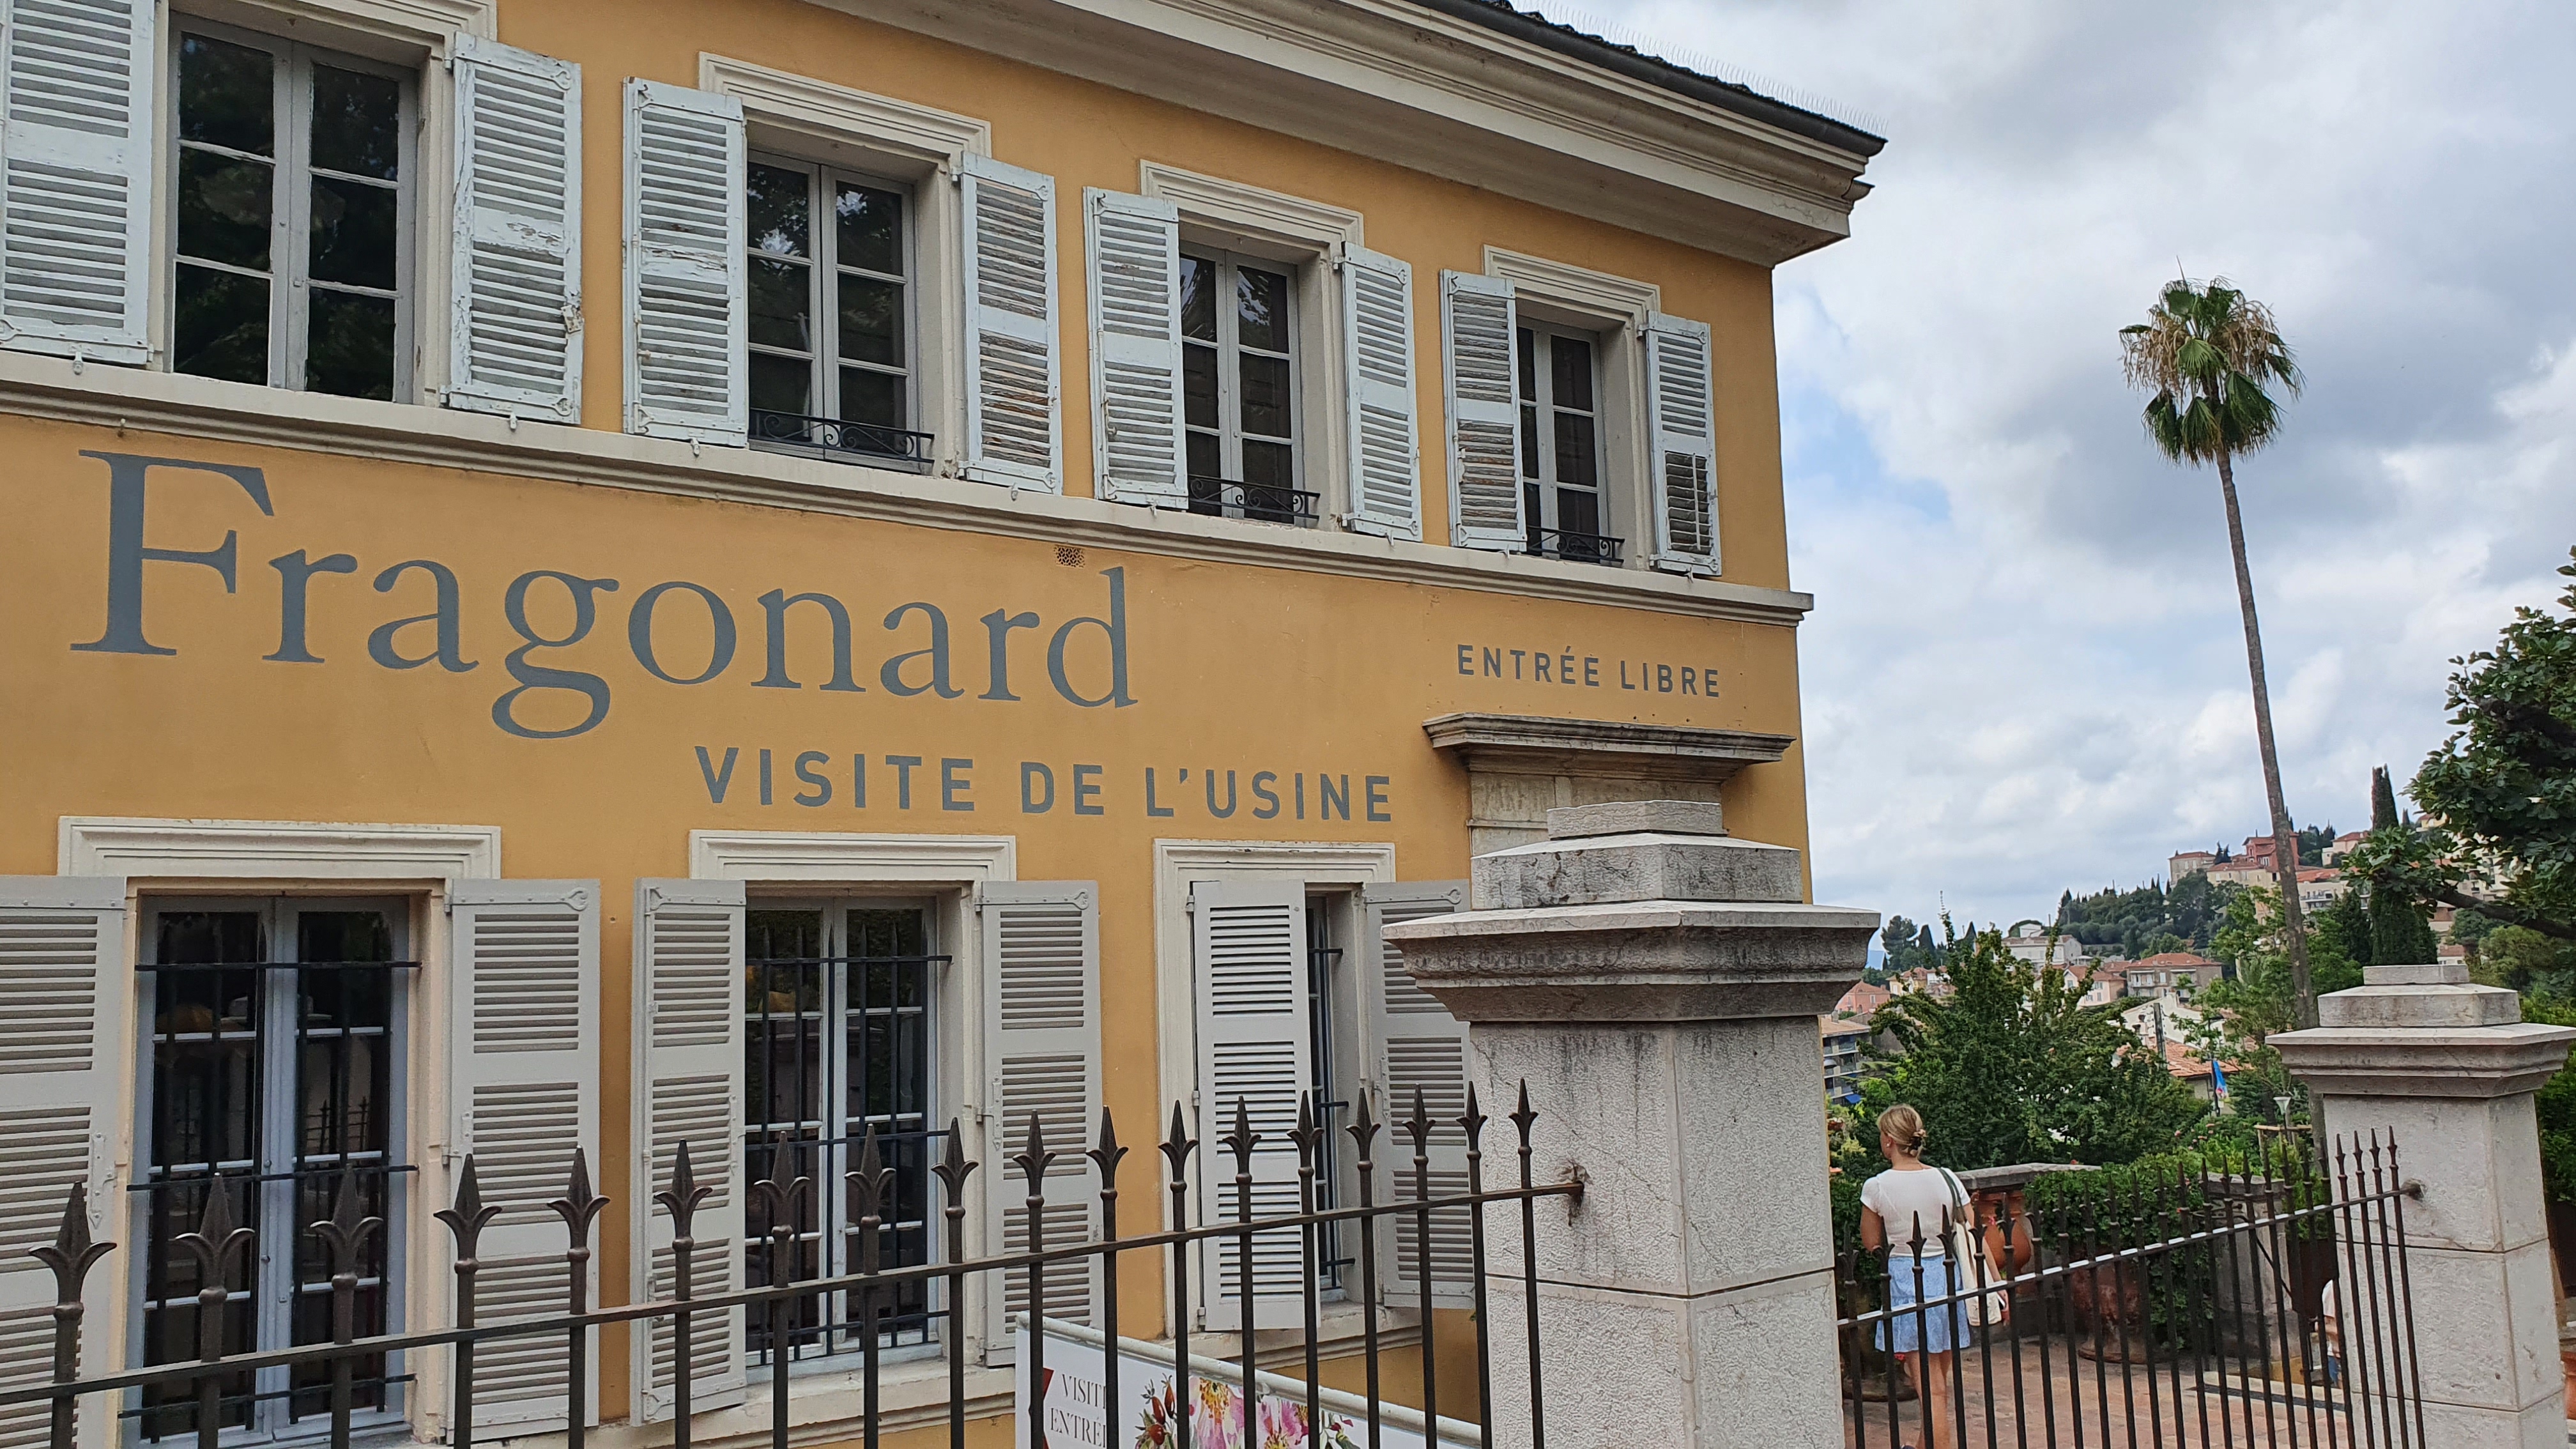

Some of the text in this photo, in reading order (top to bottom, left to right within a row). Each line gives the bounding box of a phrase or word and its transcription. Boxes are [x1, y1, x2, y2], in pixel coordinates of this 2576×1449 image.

[70, 450, 1138, 739] Fragonard
[1457, 645, 1720, 698] ENTRÉE LIBRE
[694, 746, 975, 811] VISITE
[1020, 762, 1104, 816] DE
